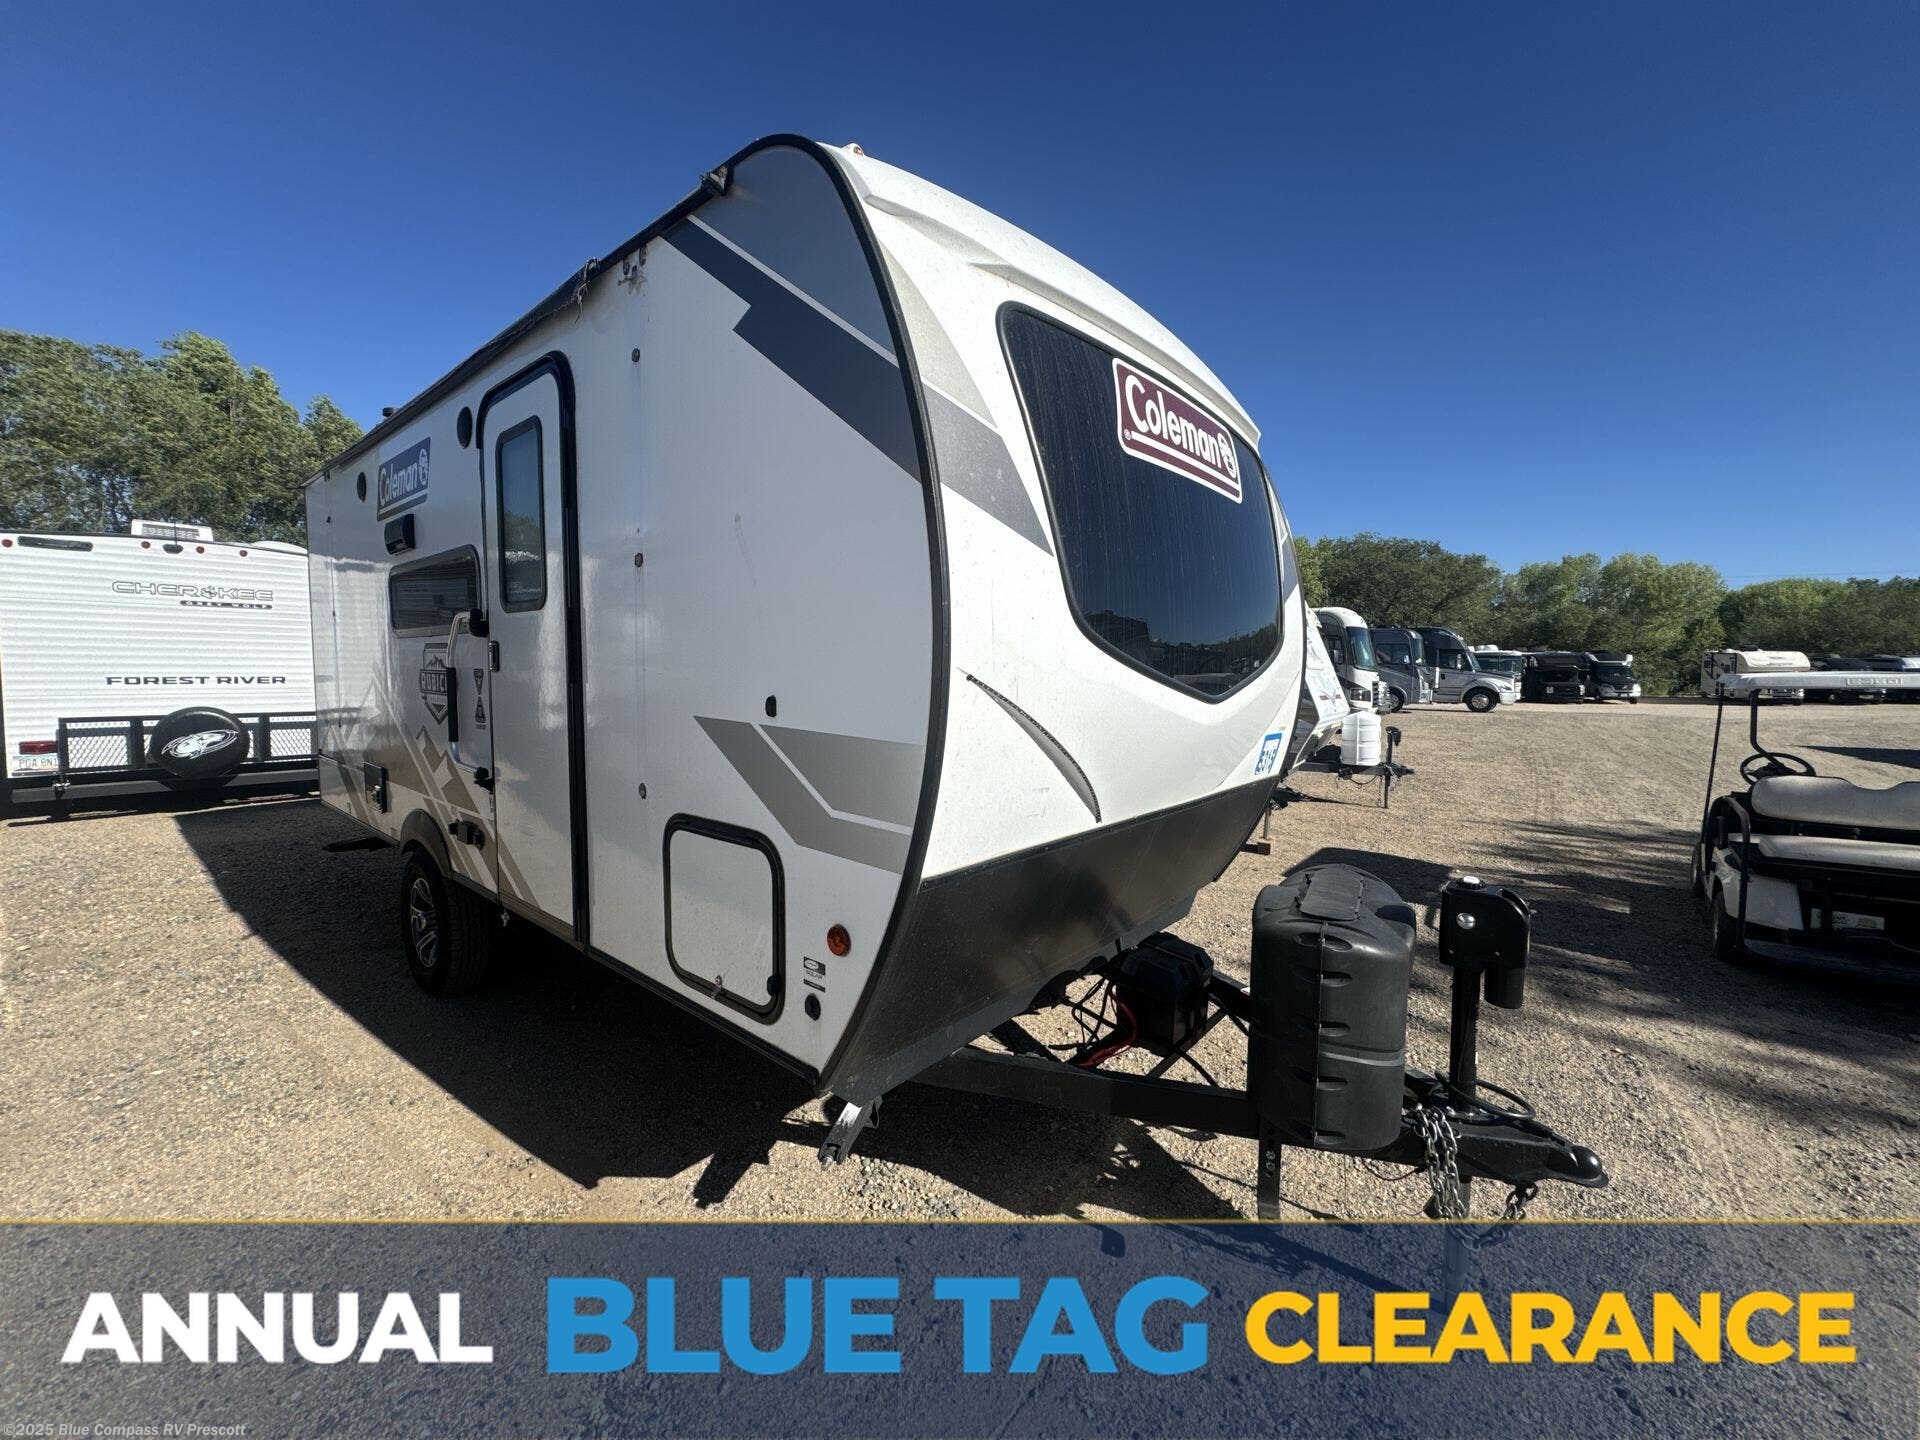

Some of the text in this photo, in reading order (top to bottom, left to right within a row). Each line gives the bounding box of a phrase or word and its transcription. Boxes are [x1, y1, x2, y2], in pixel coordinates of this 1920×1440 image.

[1125, 374, 1222, 469] Coleman
[380, 462, 418, 507] Coleman
[112, 580, 274, 602] CHEROKEE
[105, 676, 287, 685] FOREST RIVER
[420, 671, 448, 694] RUBIC
